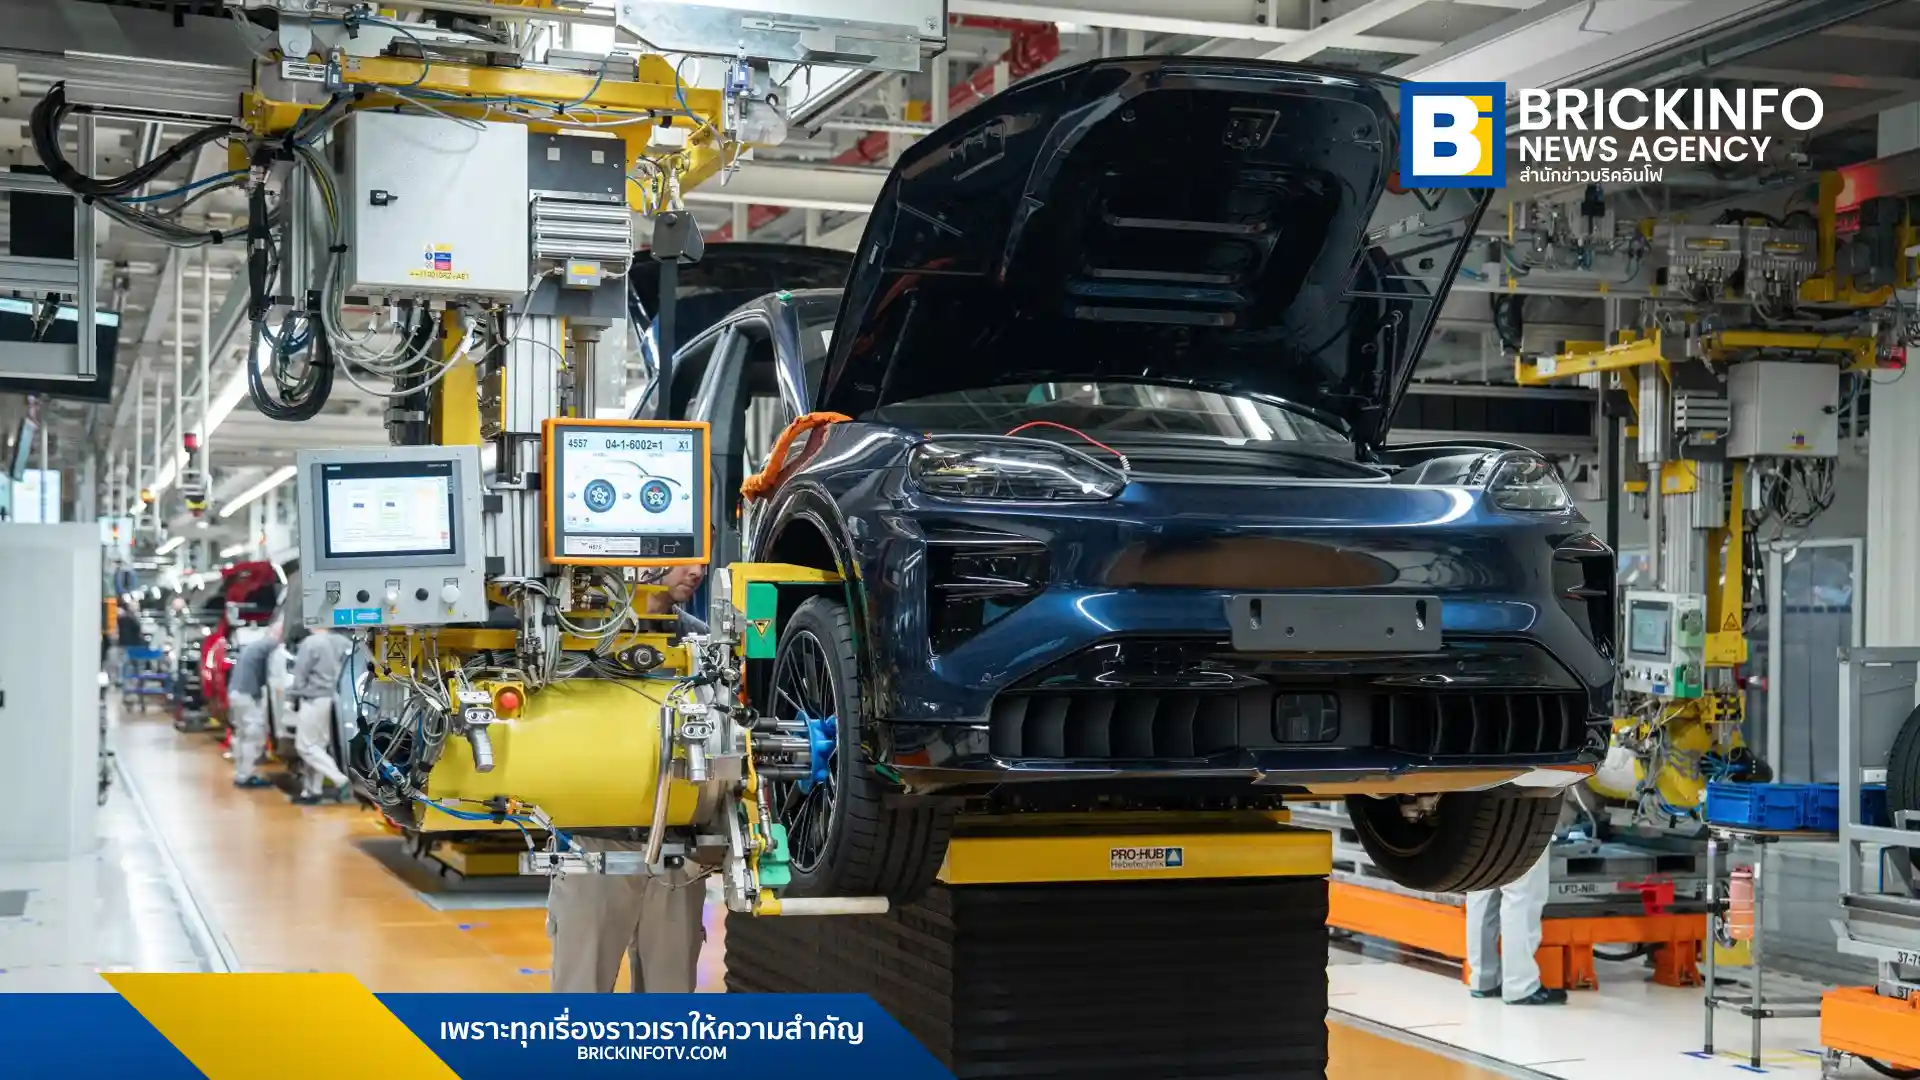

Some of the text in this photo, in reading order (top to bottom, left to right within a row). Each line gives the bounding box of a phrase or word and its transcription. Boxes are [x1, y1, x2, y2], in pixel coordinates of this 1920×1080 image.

[568, 439, 689, 450] 4557 04-1-6002=1 X1
[1111, 848, 1164, 860] PRO-HUB
